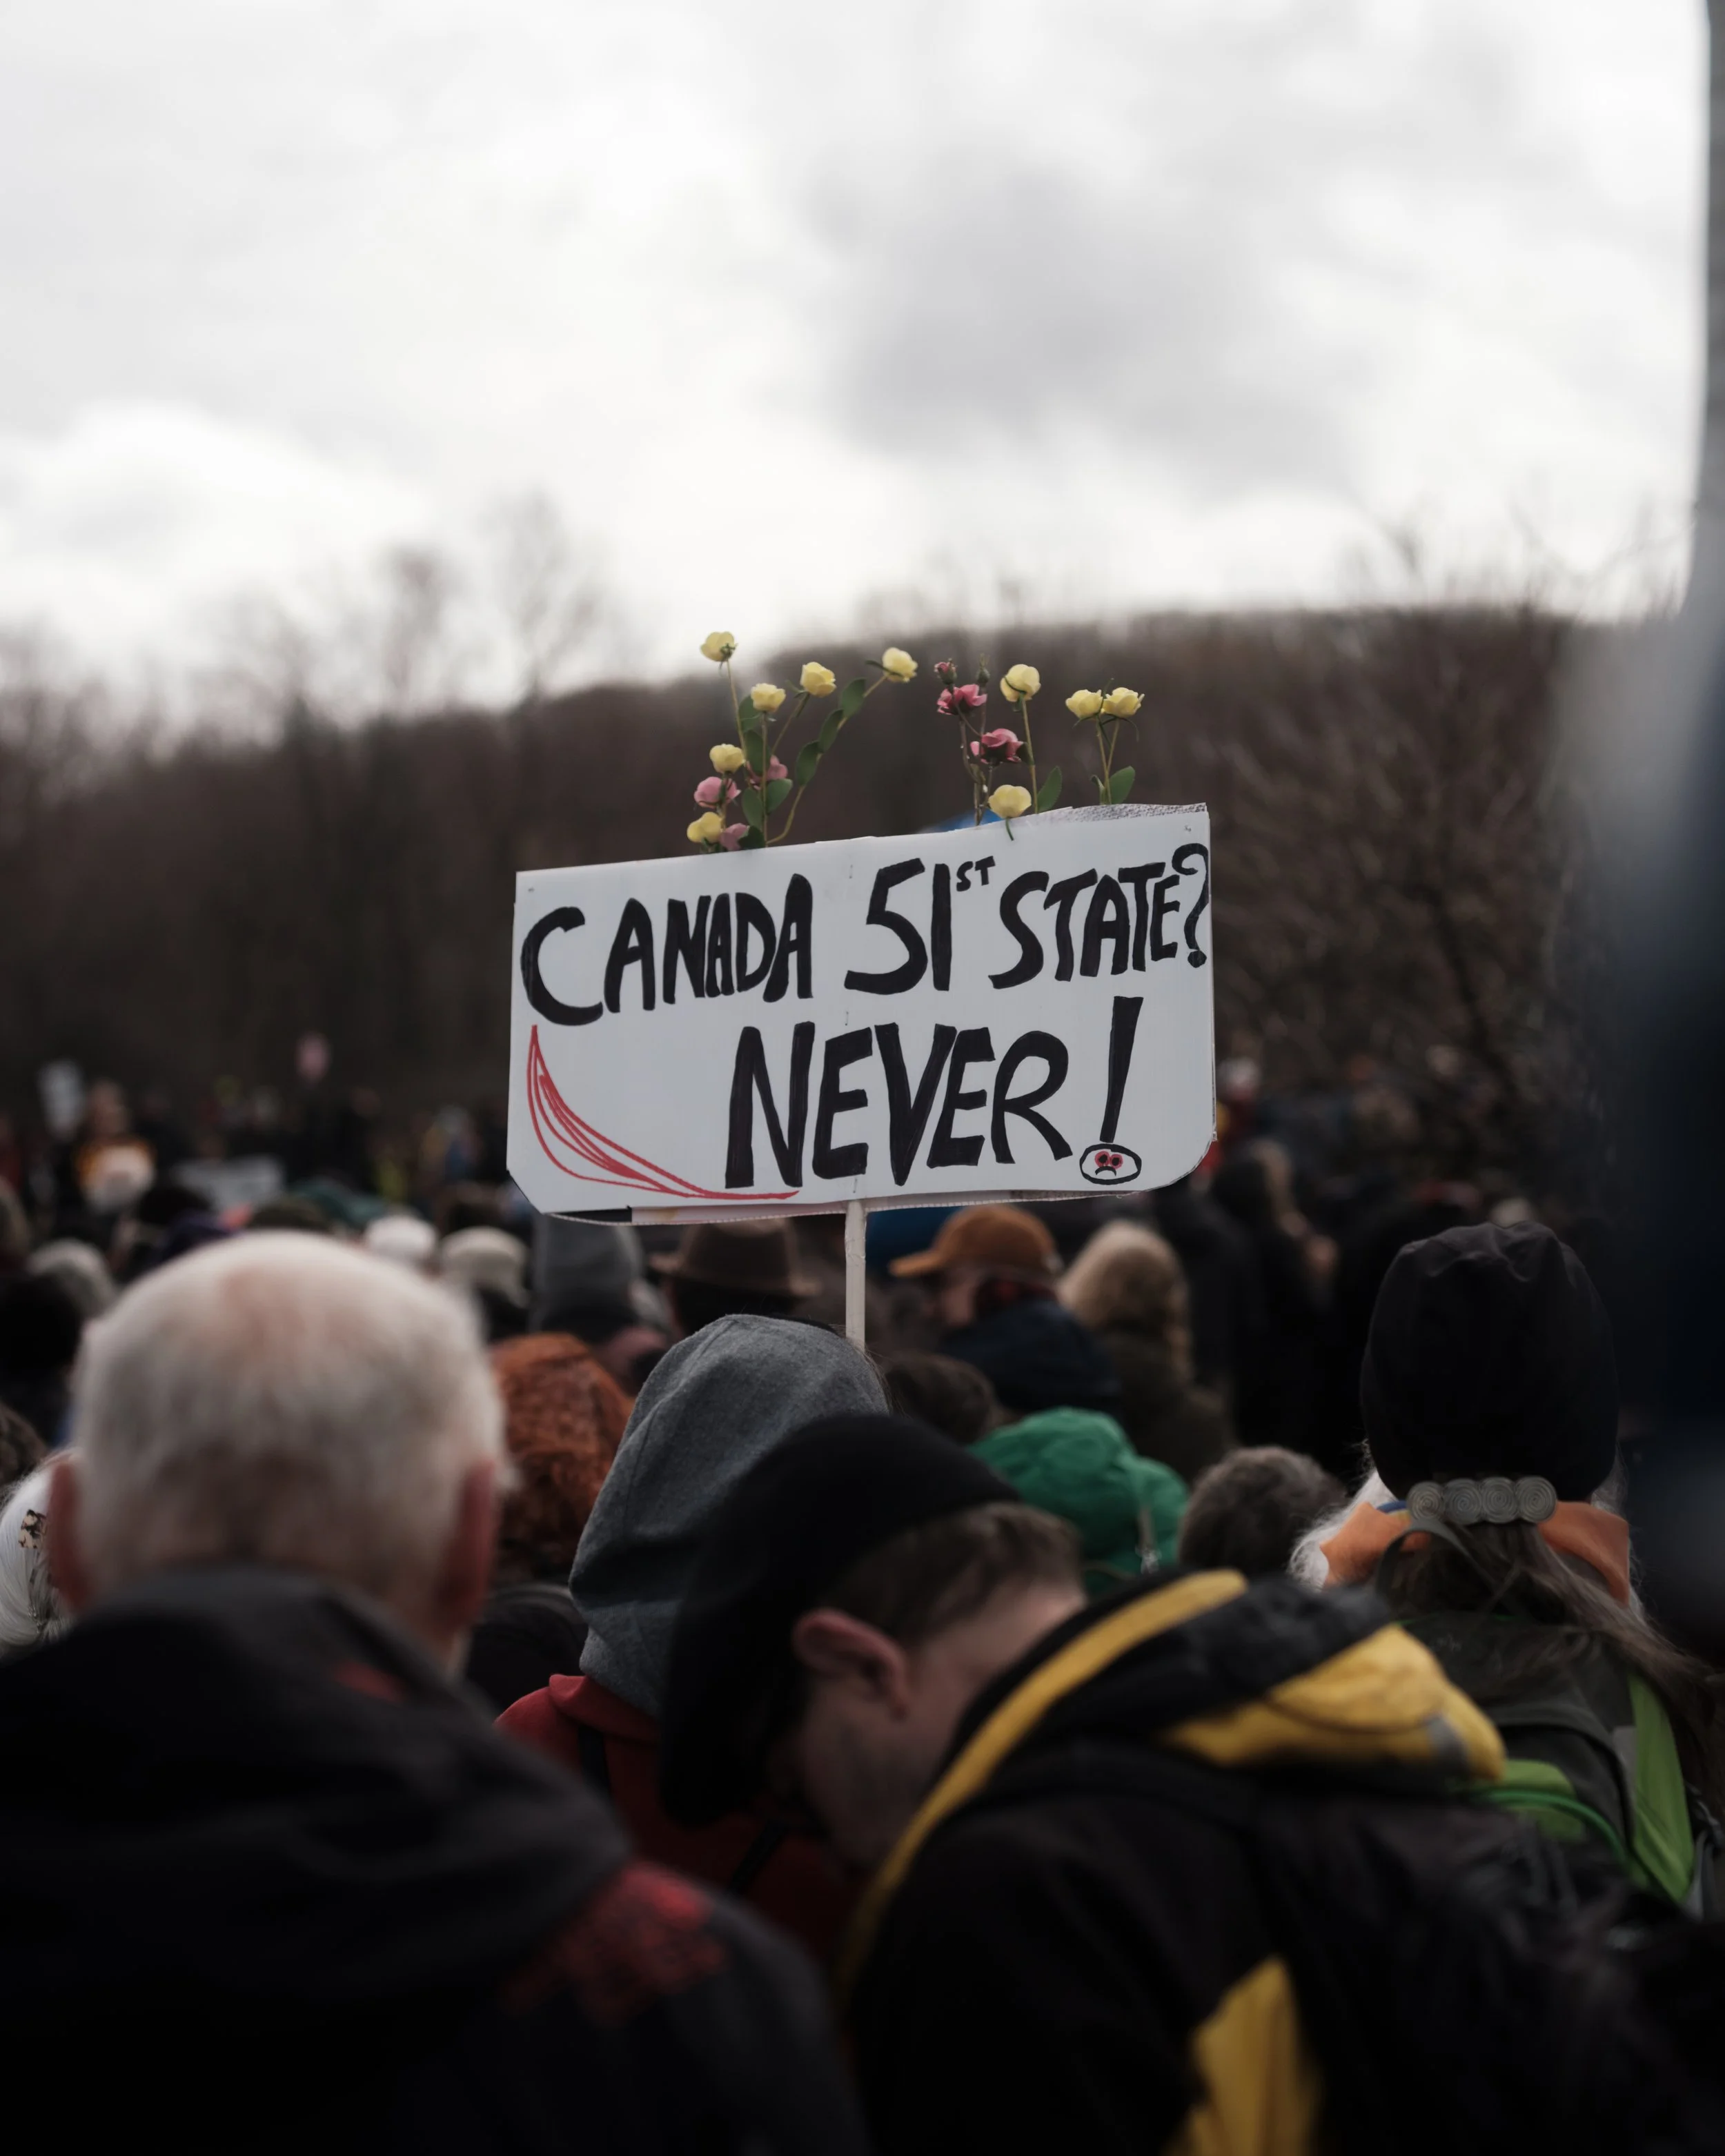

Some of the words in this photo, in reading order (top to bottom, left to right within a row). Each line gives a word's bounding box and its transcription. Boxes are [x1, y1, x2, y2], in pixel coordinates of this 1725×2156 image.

[520, 873, 813, 1026] CANADA
[987, 842, 1210, 990] STATE?
[724, 996, 1143, 1189] NEVER!
